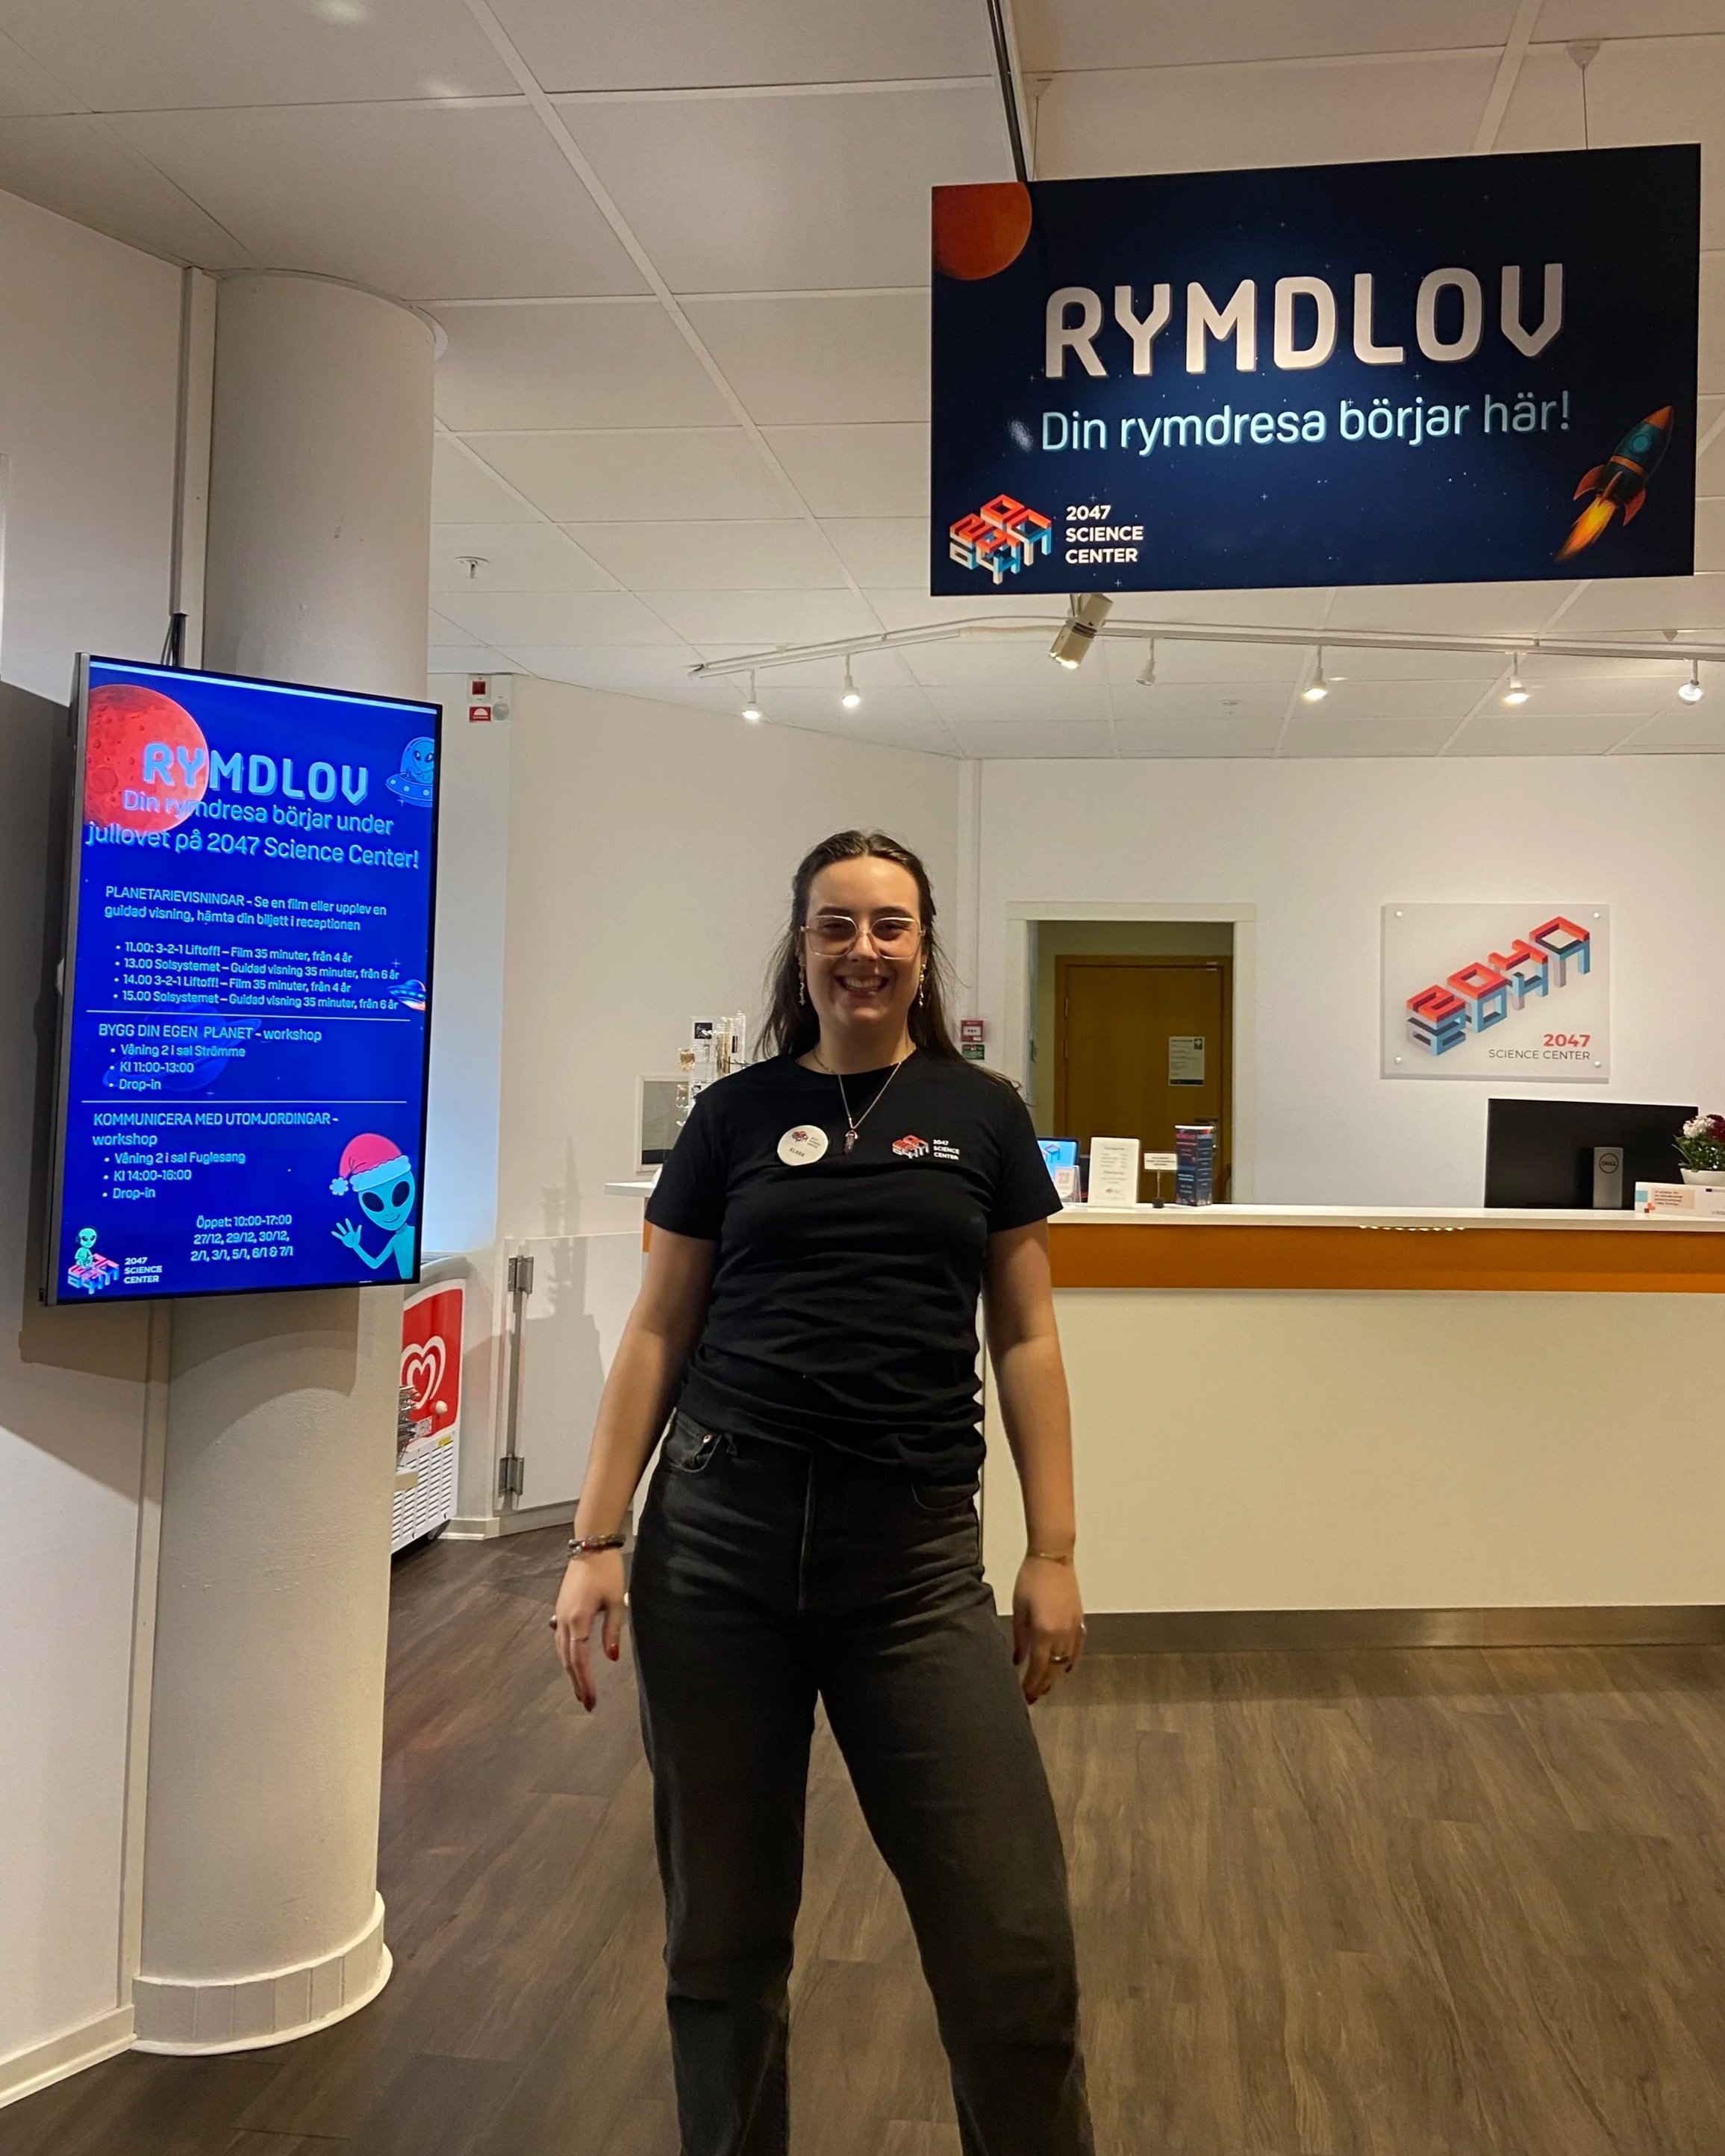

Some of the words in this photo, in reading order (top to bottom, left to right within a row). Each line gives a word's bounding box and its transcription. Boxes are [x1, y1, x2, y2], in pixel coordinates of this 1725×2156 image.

[1045, 264, 1565, 379] RYMDLOV
[1044, 412, 1106, 452] Din
[1120, 404, 1326, 456] rymdresa
[1340, 396, 1470, 446] börjar
[1484, 390, 1570, 433] här!
[1066, 505, 1111, 520] 2047
[1065, 526, 1144, 542] SCIENCE
[1065, 548, 1138, 564] CENTER
[143, 742, 369, 806] RYMDLOV
[122, 789, 160, 812] Din
[165, 798, 268, 821] rymdresa
[272, 804, 334, 832] börjar
[337, 814, 394, 836] under
[85, 820, 170, 848] jullovet
[175, 829, 203, 853] på
[207, 832, 261, 856] 2047
[264, 837, 344, 863] Science
[349, 844, 419, 870] Center!
[105, 885, 245, 906] PLANETARIEVISNINGAR
[254, 896, 269, 908] Se
[271, 899, 286, 909] en
[287, 897, 308, 911] film
[311, 900, 334, 913] eller
[336, 903, 372, 917] upplev
[373, 905, 387, 916] en
[104, 904, 147, 919] guidad
[149, 907, 195, 923] visning,
[197, 909, 235, 924] hämta
[237, 912, 255, 925] din
[257, 913, 289, 929] biljett
[296, 917, 361, 932] receptionen
[125, 941, 155, 953] 11.00:
[155, 942, 184, 955] 3-2-1
[185, 944, 221, 957] Liftoff!
[231, 947, 253, 959] Film
[255, 948, 268, 959] 35
[269, 949, 311, 963] minuter,
[312, 950, 332, 962] från
[334, 952, 340, 963] 4
[342, 951, 353, 963] år
[124, 958, 153, 970] 13.00
[155, 959, 220, 973] Solsystemet
[231, 962, 266, 975] Guidad
[267, 964, 303, 979] visning
[305, 966, 318, 977] 35
[319, 967, 359, 980] minuter,
[360, 968, 380, 979] från
[381, 969, 388, 979] 6
[389, 968, 400, 980] år
[123, 974, 152, 985] 14.00
[154, 975, 181, 987] 3-2-1
[184, 976, 219, 988] Liftoff!
[229, 978, 252, 990] Film
[253, 979, 266, 990] 35
[268, 979, 309, 993] minuter,
[311, 981, 331, 993] från
[332, 982, 339, 993] 4
[340, 981, 352, 994] år
[122, 990, 152, 1002] 15.00
[153, 991, 219, 1005] Solsystemet
[229, 994, 266, 1006] Guidad
[266, 995, 302, 1009] visning
[303, 997, 316, 1008] 35
[318, 997, 358, 1011] minuter,
[359, 998, 379, 1009] från
[380, 1000, 387, 1010] 6
[387, 999, 399, 1010] år
[99, 1024, 135, 1038] BYGG
[137, 1024, 160, 1038] DIN
[163, 1025, 198, 1038] EGEN
[204, 1026, 254, 1039] PLANET
[263, 1028, 322, 1044] workshop
[1544, 1034, 1591, 1047] 2047
[121, 1043, 159, 1059] Våning
[160, 1045, 169, 1056] 2
[176, 1044, 193, 1057] sal
[195, 1044, 246, 1058] Strömme
[1488, 1049, 1539, 1059] SCIENCE
[1543, 1050, 1591, 1060] CENTER
[119, 1061, 131, 1073] Kl
[133, 1062, 195, 1074] 11:00-13:00
[119, 1078, 162, 1092] Drop-in
[93, 1112, 193, 1127] KOMMUNICERA
[195, 1112, 223, 1126] MED
[225, 1112, 331, 1126] UTOMJORDINGAR
[92, 1132, 158, 1148] workshop
[115, 1151, 155, 1166] Våning
[155, 1153, 164, 1164] 2
[170, 1151, 187, 1164] sal
[189, 1151, 246, 1165] Fuglesang
[933, 1146, 960, 1155] SCIENCE
[934, 1152, 959, 1160] CENTER
[113, 1169, 125, 1182] Kl
[127, 1169, 193, 1182] 14:00-16:00
[113, 1186, 157, 1201] Drop-in
[196, 1214, 232, 1230] Öppet:
[234, 1213, 293, 1227] 10:00-17:00
[193, 1233, 225, 1246] 27/12,
[225, 1232, 258, 1244] 29/12,
[258, 1230, 290, 1243] 30/12,
[125, 1257, 148, 1265] 2047
[190, 1250, 210, 1262] 2/1,
[211, 1249, 231, 1262] 3/1,
[232, 1247, 251, 1260] 5/1,
[252, 1247, 268, 1259] 6/1
[279, 1245, 294, 1257] 7/1
[124, 1265, 163, 1275] SCIENCE
[123, 1275, 160, 1284] CENTER
